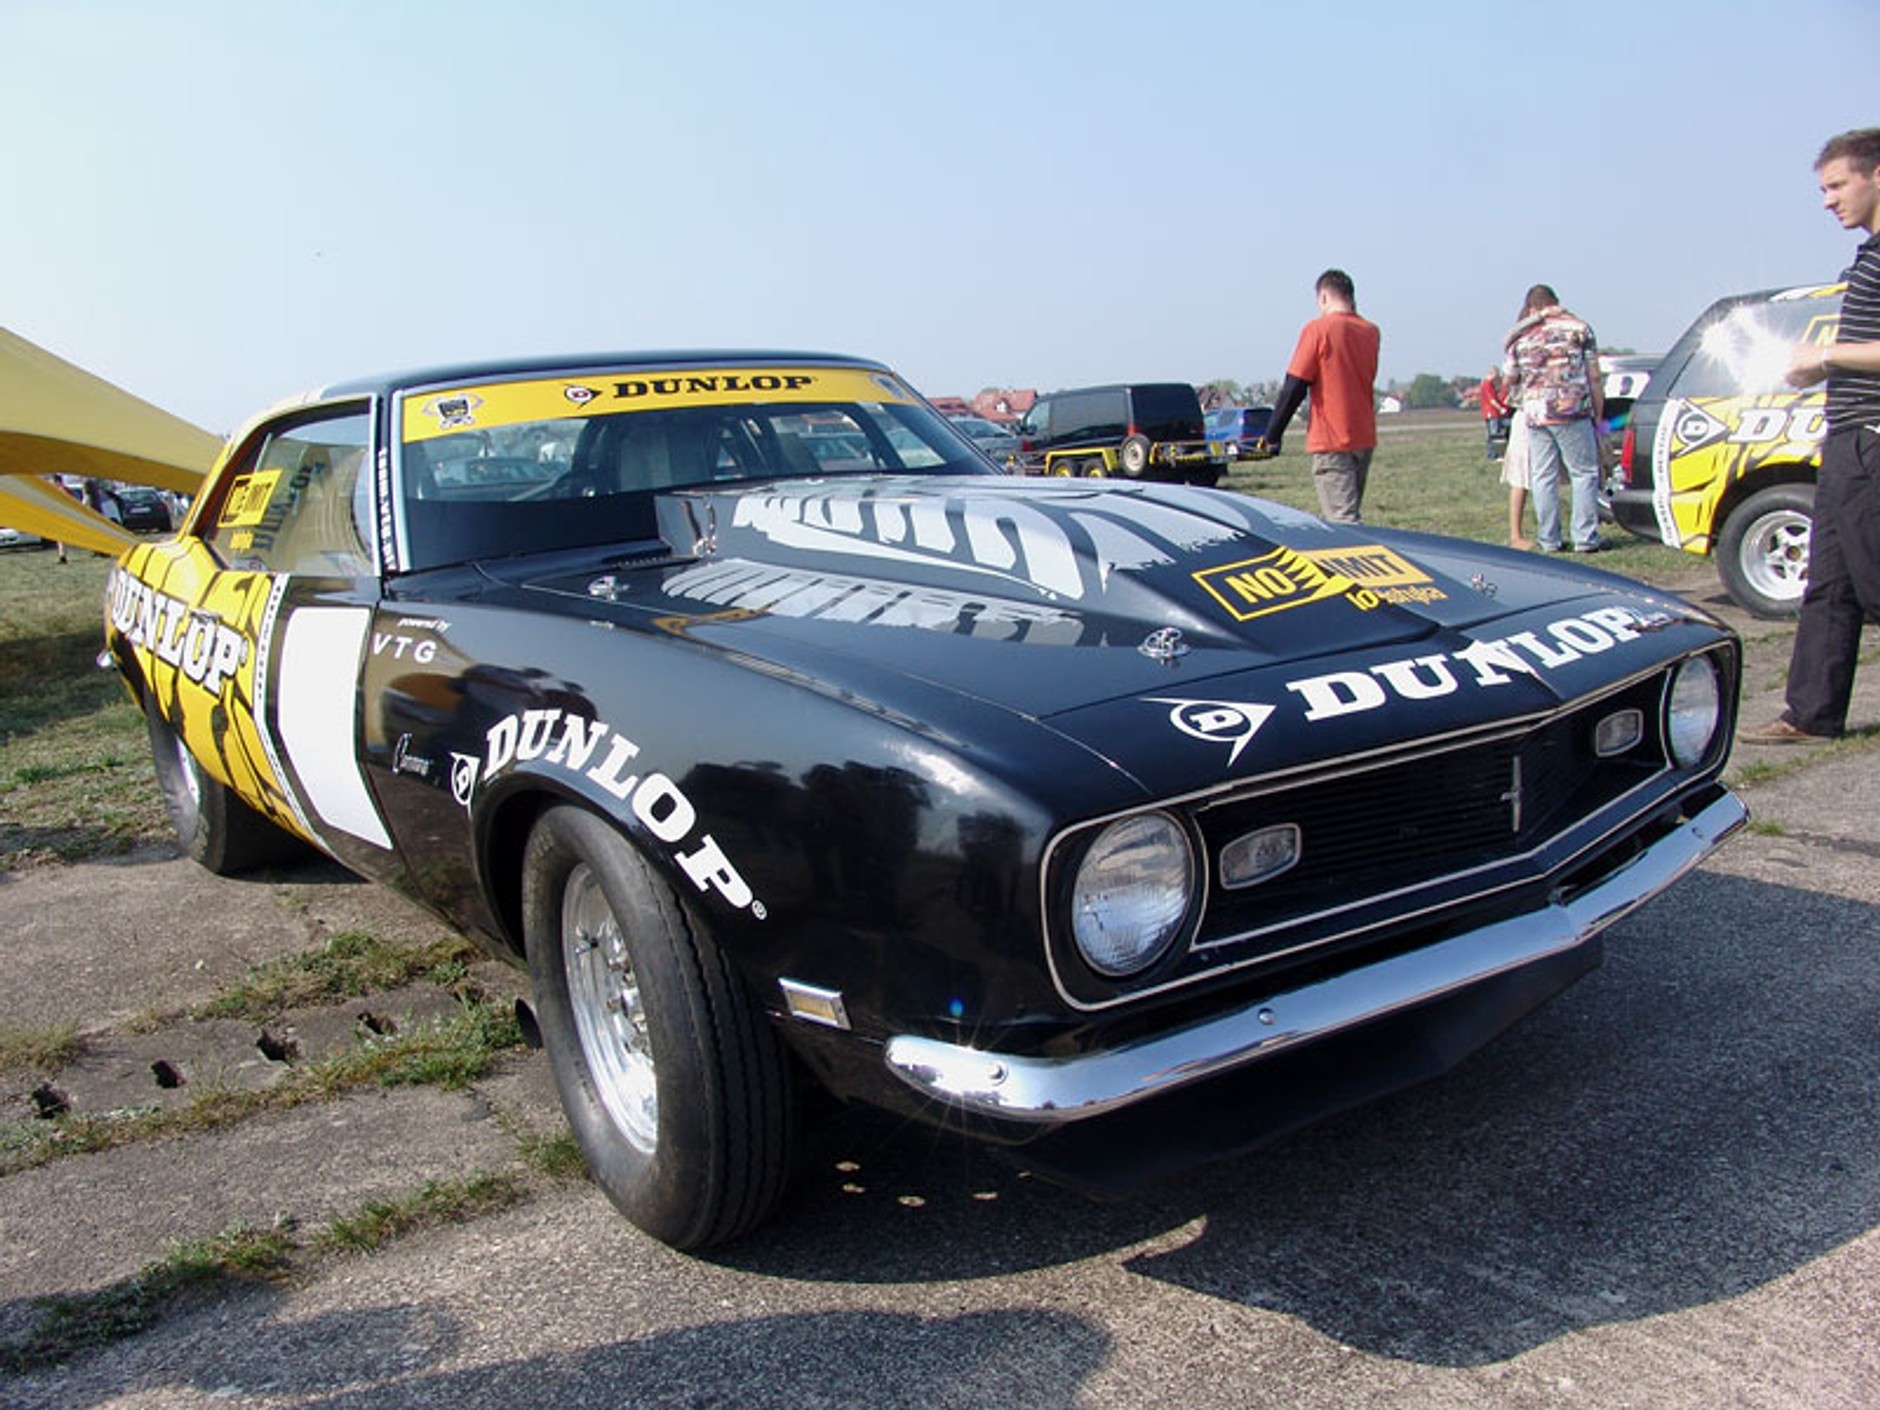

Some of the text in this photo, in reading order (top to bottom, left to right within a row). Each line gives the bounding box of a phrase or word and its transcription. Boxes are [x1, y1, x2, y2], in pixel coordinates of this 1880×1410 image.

[612, 375, 812, 399] DUNLOP
[1224, 566, 1298, 604] NO
[1287, 607, 1641, 722] DUNLOP
[483, 708, 755, 909] DUNLOP
